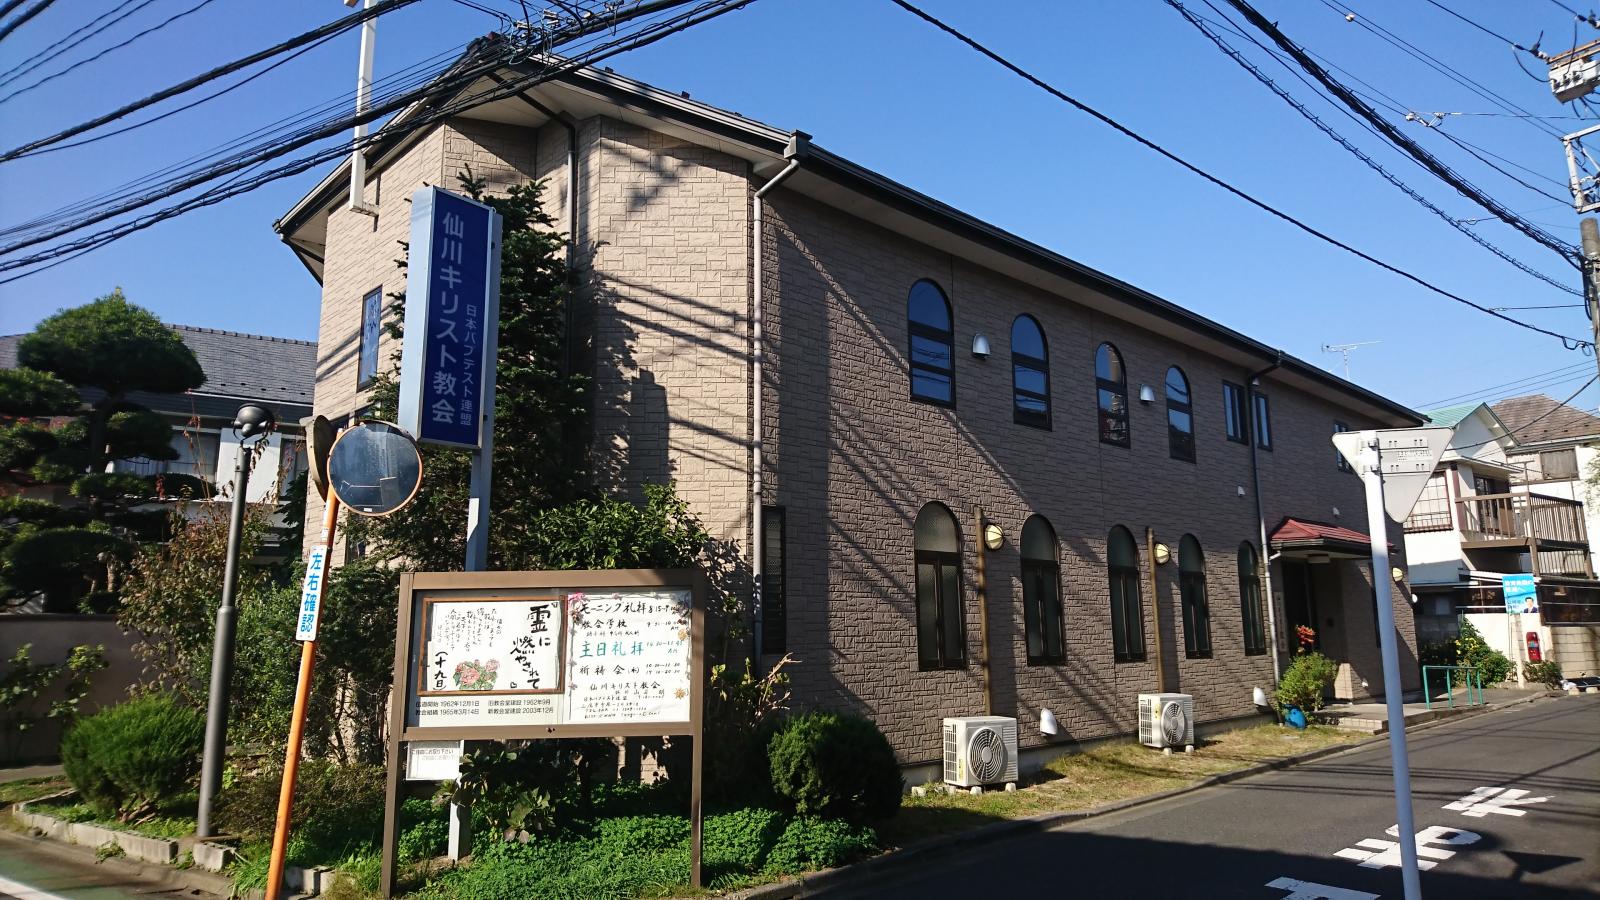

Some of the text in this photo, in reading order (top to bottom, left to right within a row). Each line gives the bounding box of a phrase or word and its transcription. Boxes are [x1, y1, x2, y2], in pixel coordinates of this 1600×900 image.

[432, 211, 465, 424] 仙川キリスト教会
[460, 304, 478, 427] 日本バプテスト連盟
[300, 552, 323, 632] 左右確認
[579, 641, 645, 658] 主日礼拝
